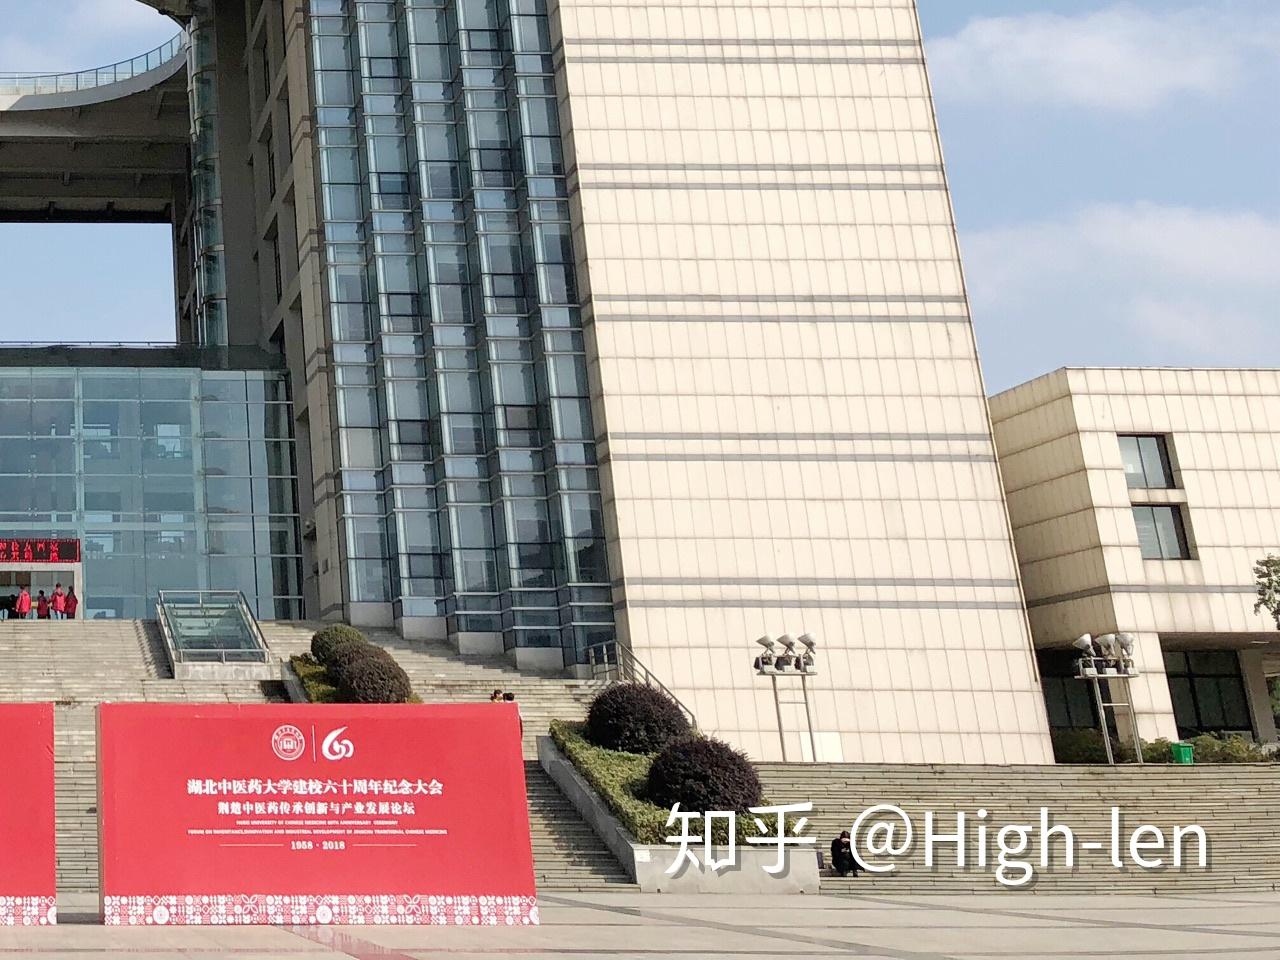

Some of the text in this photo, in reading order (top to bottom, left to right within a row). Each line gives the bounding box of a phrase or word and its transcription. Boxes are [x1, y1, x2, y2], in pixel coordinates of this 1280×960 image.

[186, 778, 444, 796] 湖北中医药大学建校六十周年纪念大会
[217, 801, 416, 815] 荆楚中医药传承创新与产业发展论坛
[291, 840, 346, 850] 1958 2018
